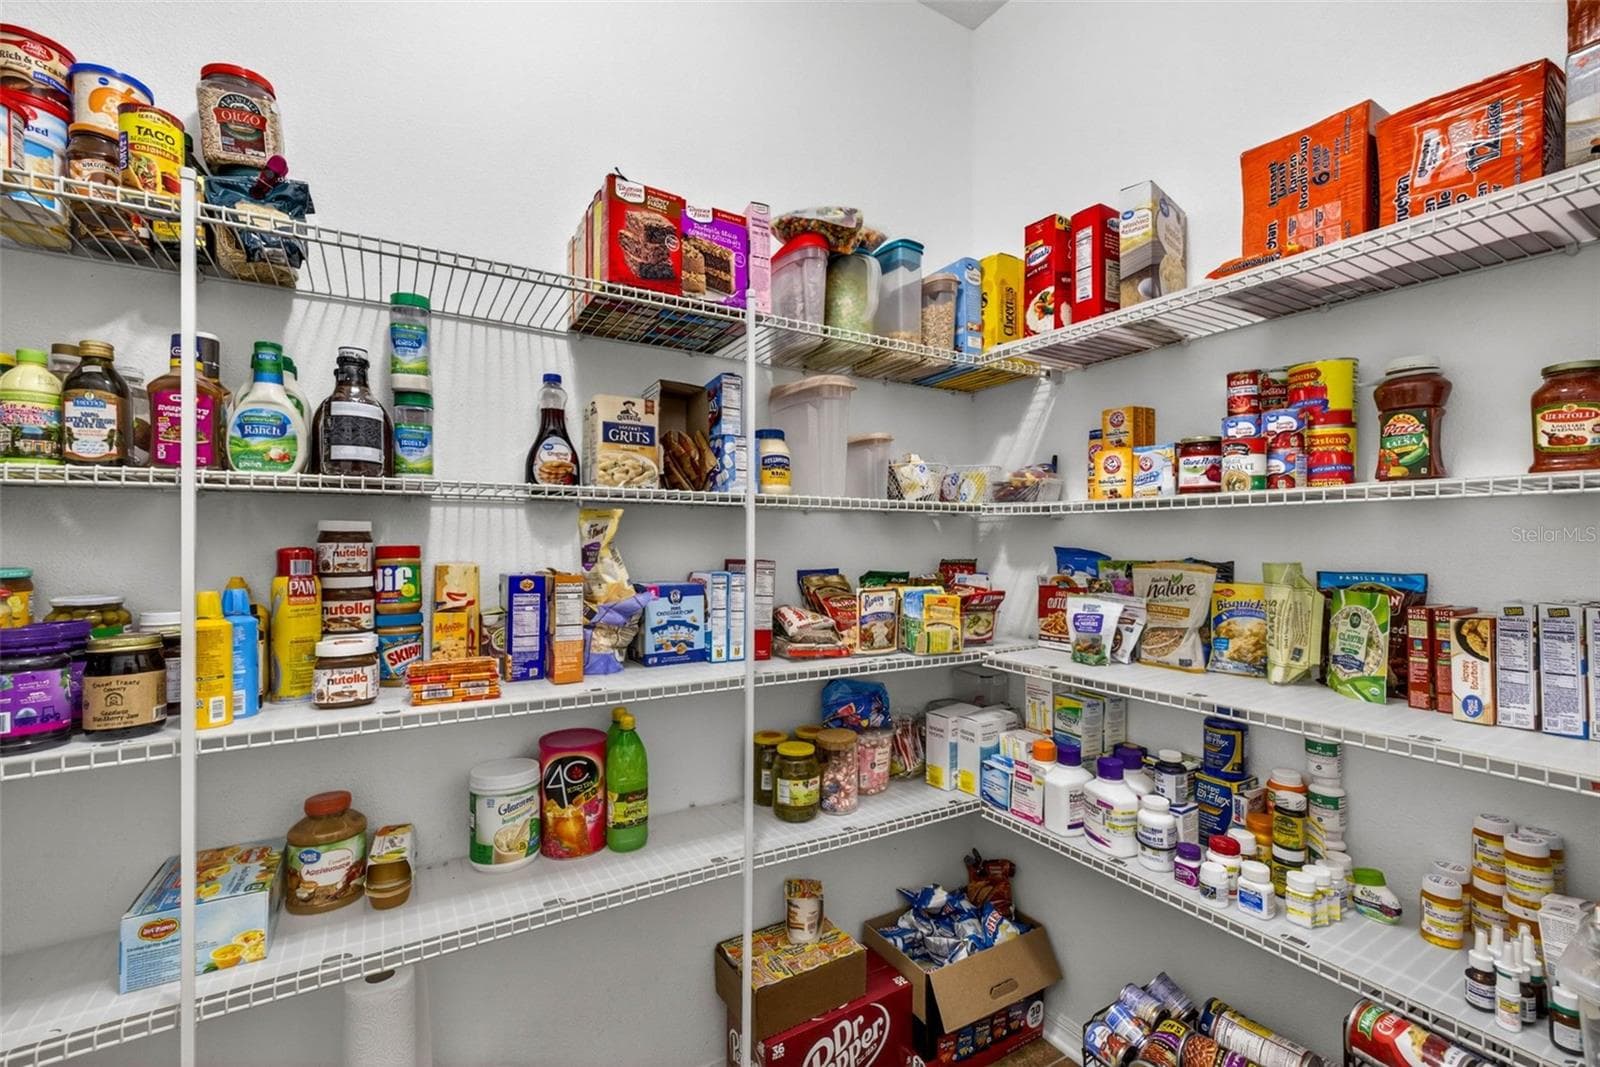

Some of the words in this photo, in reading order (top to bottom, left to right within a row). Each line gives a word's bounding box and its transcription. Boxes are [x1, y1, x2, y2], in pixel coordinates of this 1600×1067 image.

[23, 55, 32, 65] &
[221, 110, 261, 126] ORZO
[135, 125, 176, 147] TACO
[1300, 136, 1311, 165] Soup
[1288, 154, 1298, 195] Ramen
[1312, 171, 1330, 186] 6
[1299, 166, 1309, 209] Noodle
[1003, 286, 1016, 338] Cheerios
[65, 417, 92, 425] EXTRA
[617, 414, 642, 423] QUAKER
[1544, 411, 1596, 422] BERTOLLI
[244, 423, 281, 436] Ranch
[608, 429, 650, 444] GRITS
[1383, 423, 1426, 438] Pace
[1386, 437, 1417, 449] SALSA
[333, 548, 368, 558] nutella
[375, 566, 413, 592] Jif
[1339, 574, 1376, 582] FAMILY
[288, 580, 316, 596] PAM
[1147, 580, 1196, 598] nature
[322, 604, 372, 616] nutella
[1216, 598, 1265, 611] Bisquick
[1461, 660, 1470, 682] Honey
[1470, 660, 1479, 690] Bourbon
[327, 675, 368, 686] nutella
[546, 760, 590, 808] 4C
[1198, 782, 1220, 795] Osteo
[1196, 788, 1232, 807] Bi-Flex
[305, 861, 349, 877] Applesauce
[832, 1015, 864, 1057] Dr
[771, 1042, 785, 1055] 36
